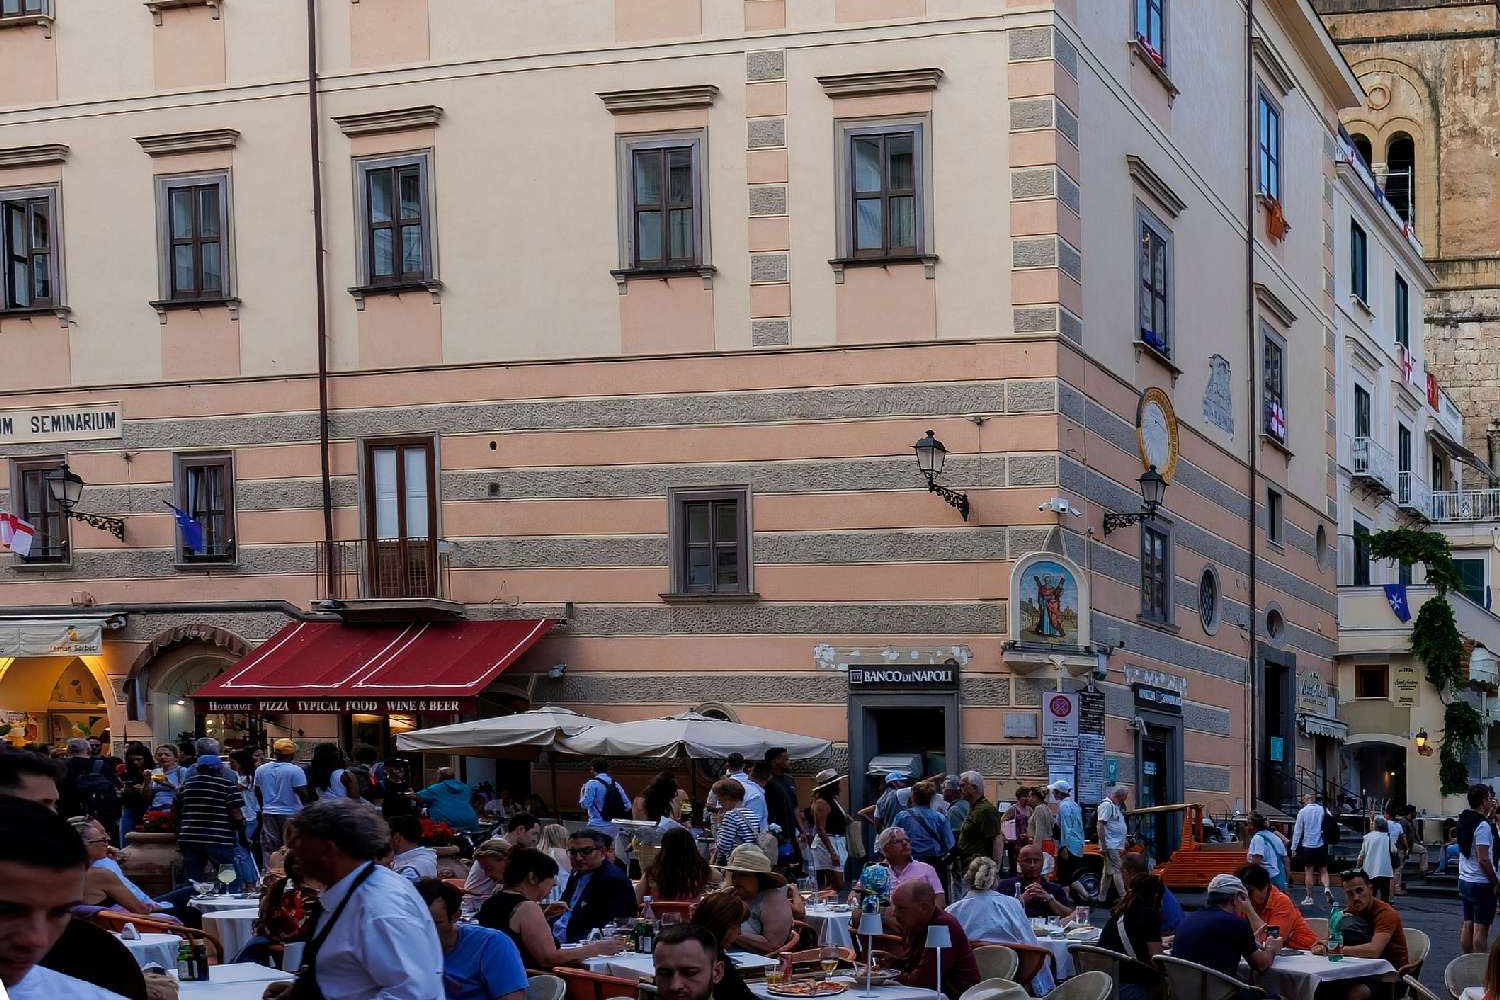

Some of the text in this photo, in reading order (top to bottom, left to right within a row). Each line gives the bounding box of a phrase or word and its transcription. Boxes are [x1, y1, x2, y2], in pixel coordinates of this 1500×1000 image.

[31, 411, 117, 434] SEMINARIUM
[864, 670, 902, 682] BANCO
[912, 670, 953, 682] NAPOLI
[259, 700, 289, 711] PIZZA
[297, 700, 341, 711] TYPICAL
[346, 700, 378, 711] FOOD
[386, 700, 417, 711] WINE
[419, 700, 427, 711] &
[429, 700, 460, 711] BEER
